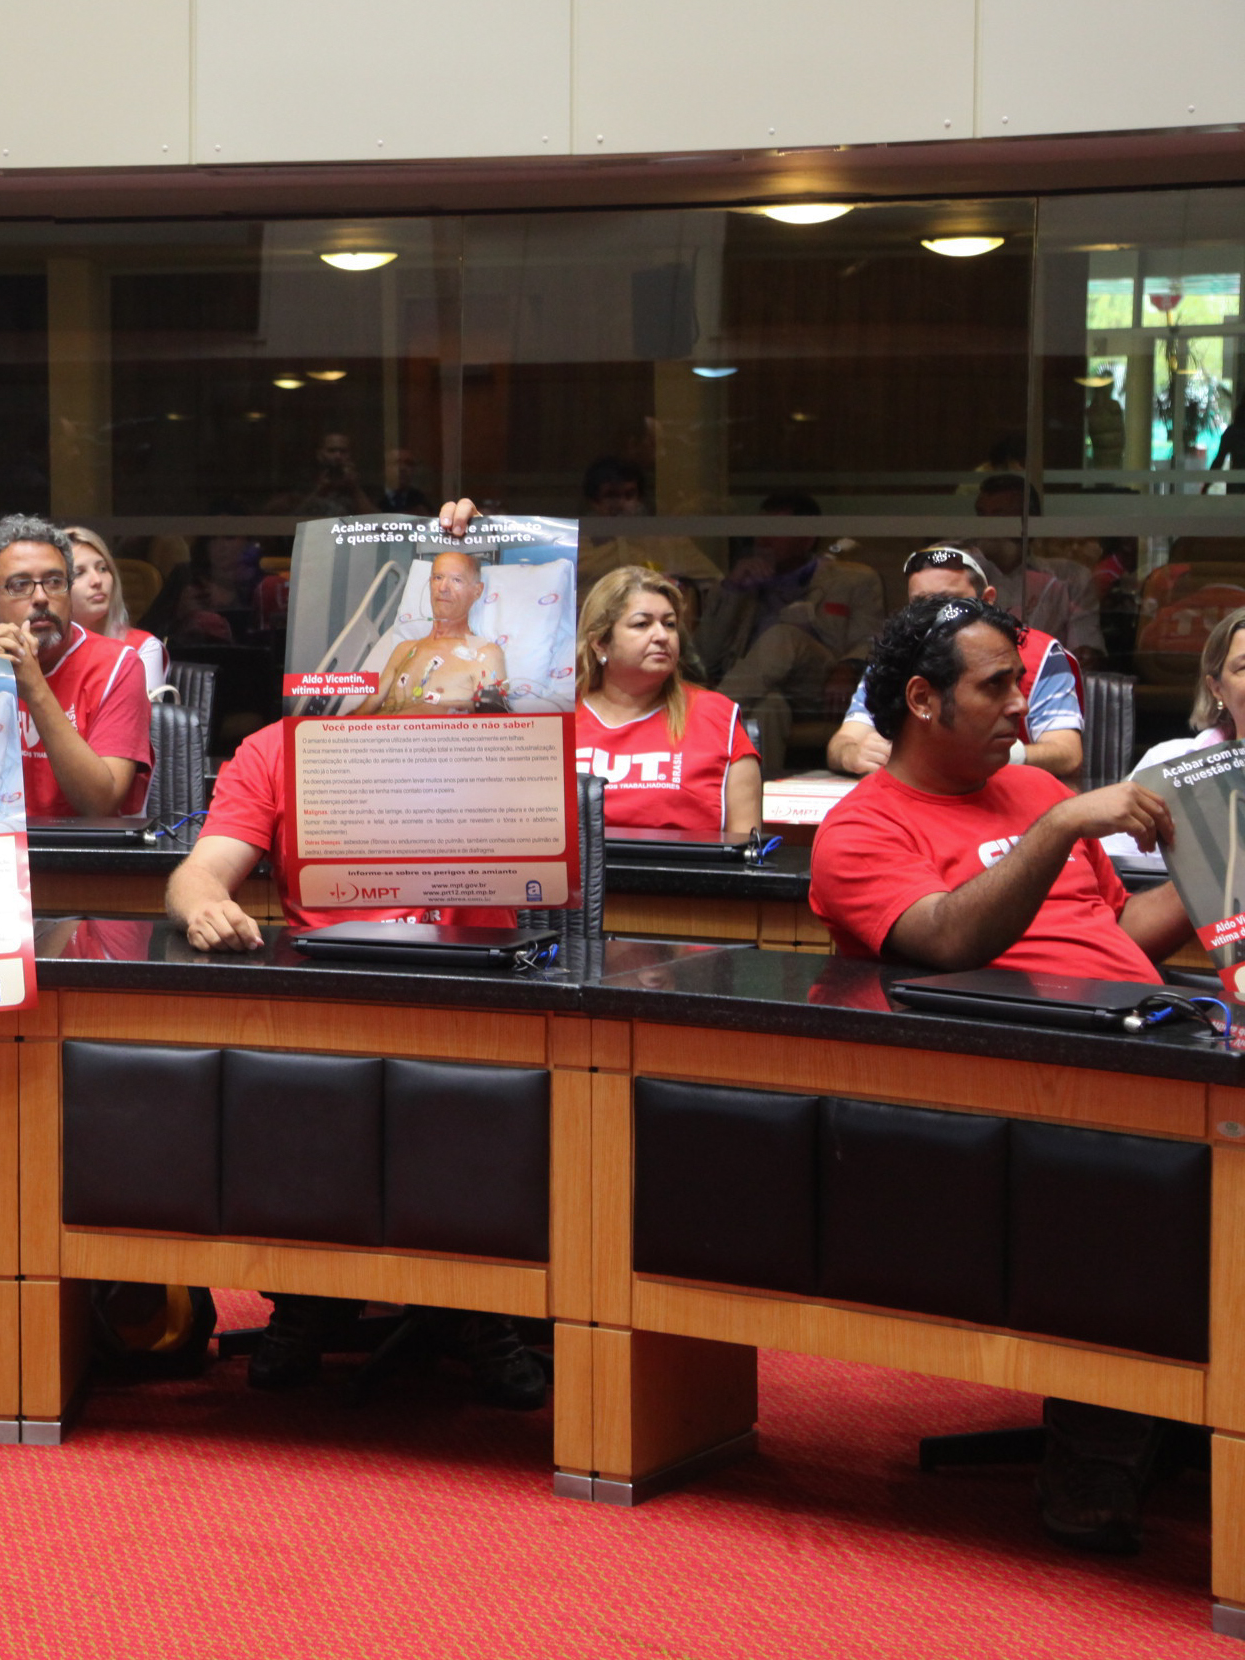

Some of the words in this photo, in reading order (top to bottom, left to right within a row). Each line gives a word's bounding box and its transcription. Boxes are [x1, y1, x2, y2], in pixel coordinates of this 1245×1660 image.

[331, 521, 378, 534] Acabar
[382, 521, 412, 532] com
[416, 524, 426, 533] o
[429, 523, 453, 533] us
[480, 521, 542, 532] amianto
[335, 534, 344, 545] é
[347, 532, 404, 545] questão
[408, 532, 427, 543] de
[430, 533, 460, 546] vida
[464, 536, 483, 545] ou
[487, 532, 535, 543] morte.
[302, 674, 323, 684] Aldo
[325, 673, 365, 684] Vicentin,
[291, 685, 321, 694] vítima
[322, 685, 335, 694] do
[337, 684, 375, 694] amianto
[322, 723, 345, 731] Você
[348, 723, 373, 732] pode
[376, 723, 400, 731] estar
[403, 721, 469, 731] contaminado
[481, 721, 500, 729] não
[503, 720, 535, 729] saber!
[672, 752, 683, 783] BRASIL
[1162, 758, 1204, 779] Acabar
[1206, 749, 1233, 764] com
[1173, 776, 1182, 788] é
[1183, 762, 1232, 786] questão
[620, 782, 681, 790] TRABALHADORES
[361, 887, 401, 899] MPT
[1216, 920, 1237, 934] Aldo
